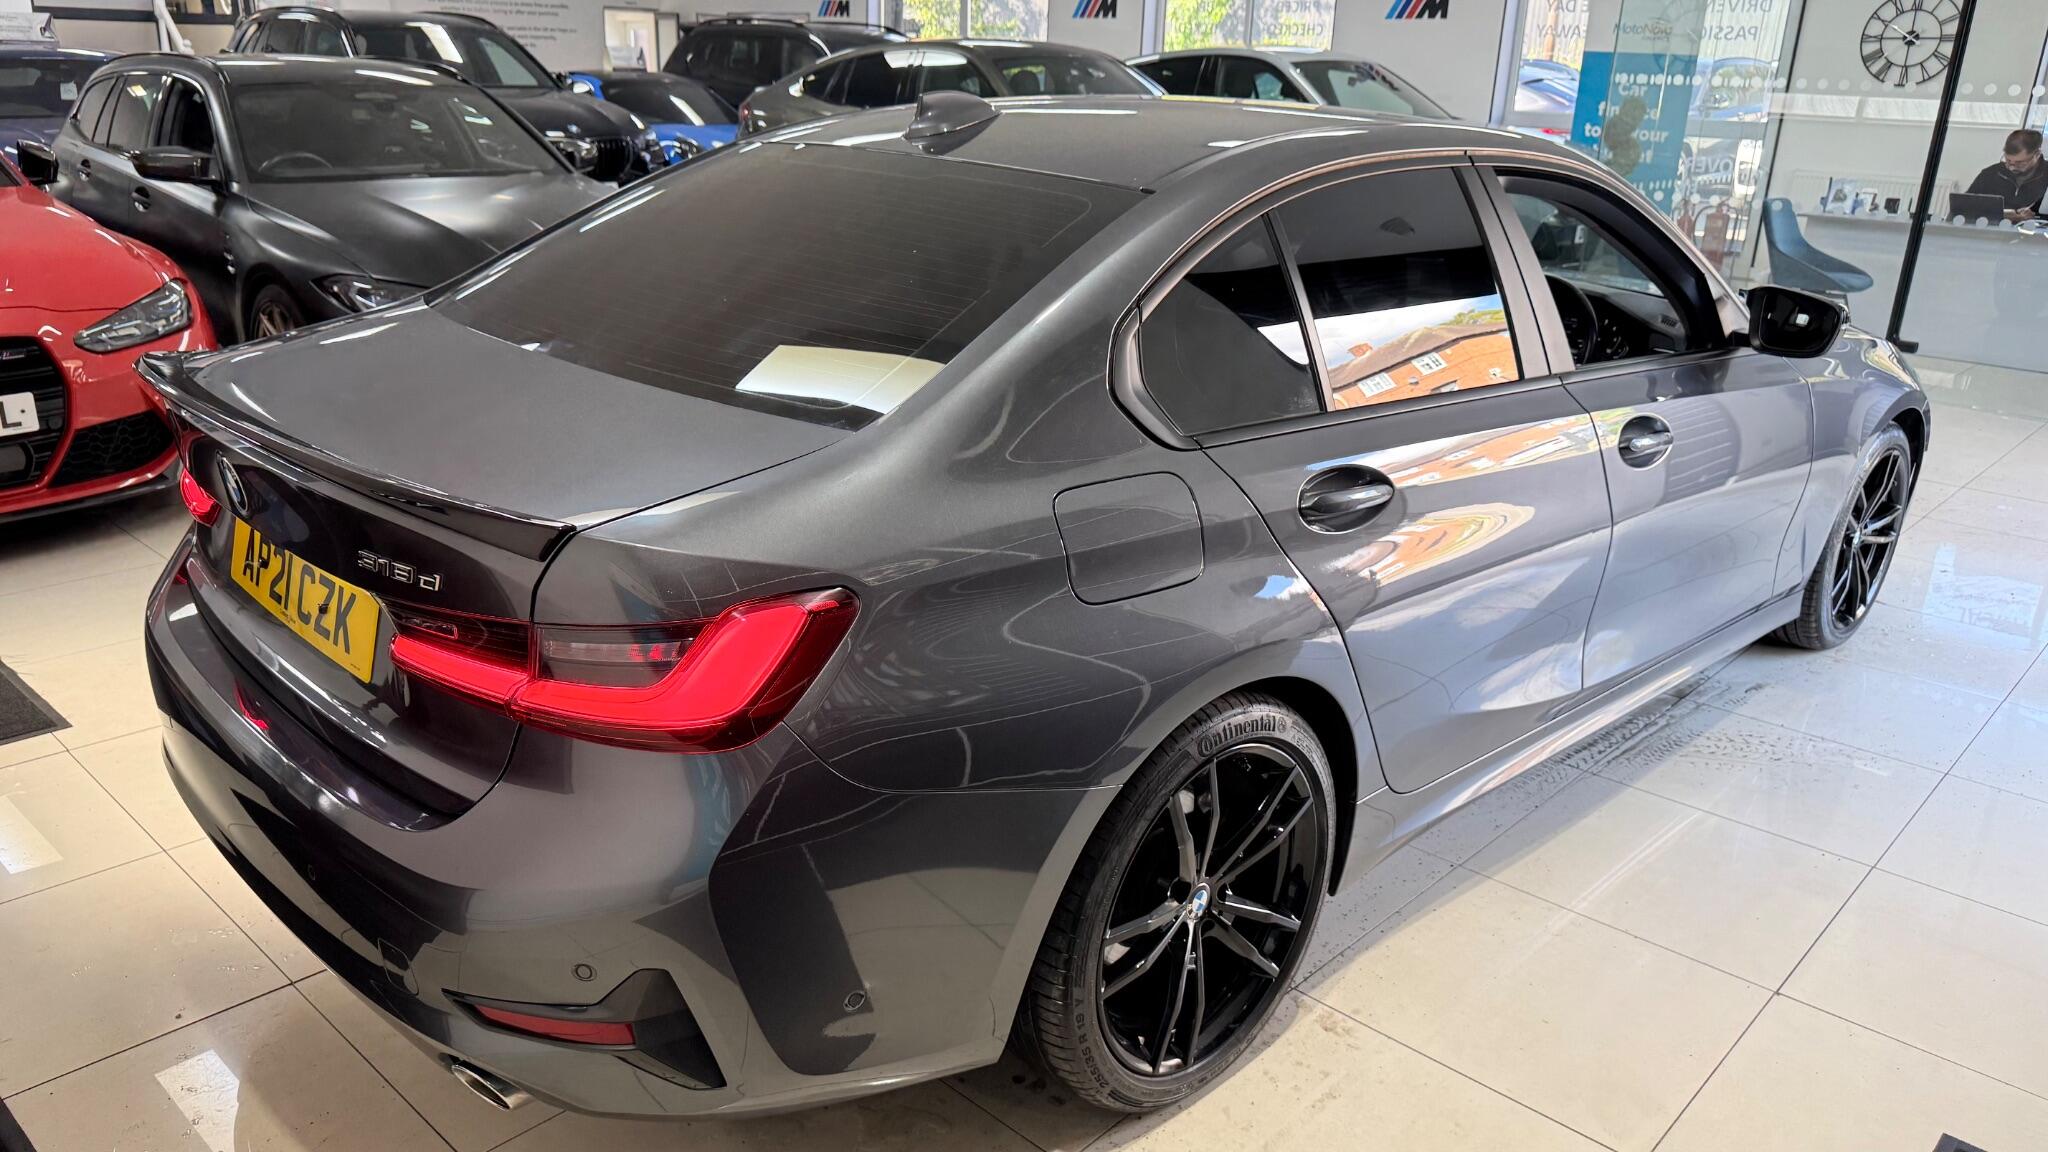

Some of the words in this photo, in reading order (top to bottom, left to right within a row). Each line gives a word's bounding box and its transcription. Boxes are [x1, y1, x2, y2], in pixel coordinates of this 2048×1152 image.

[1618, 83, 1648, 97] Car
[358, 549, 443, 592] 318d
[1198, 713, 1276, 758] Continental
